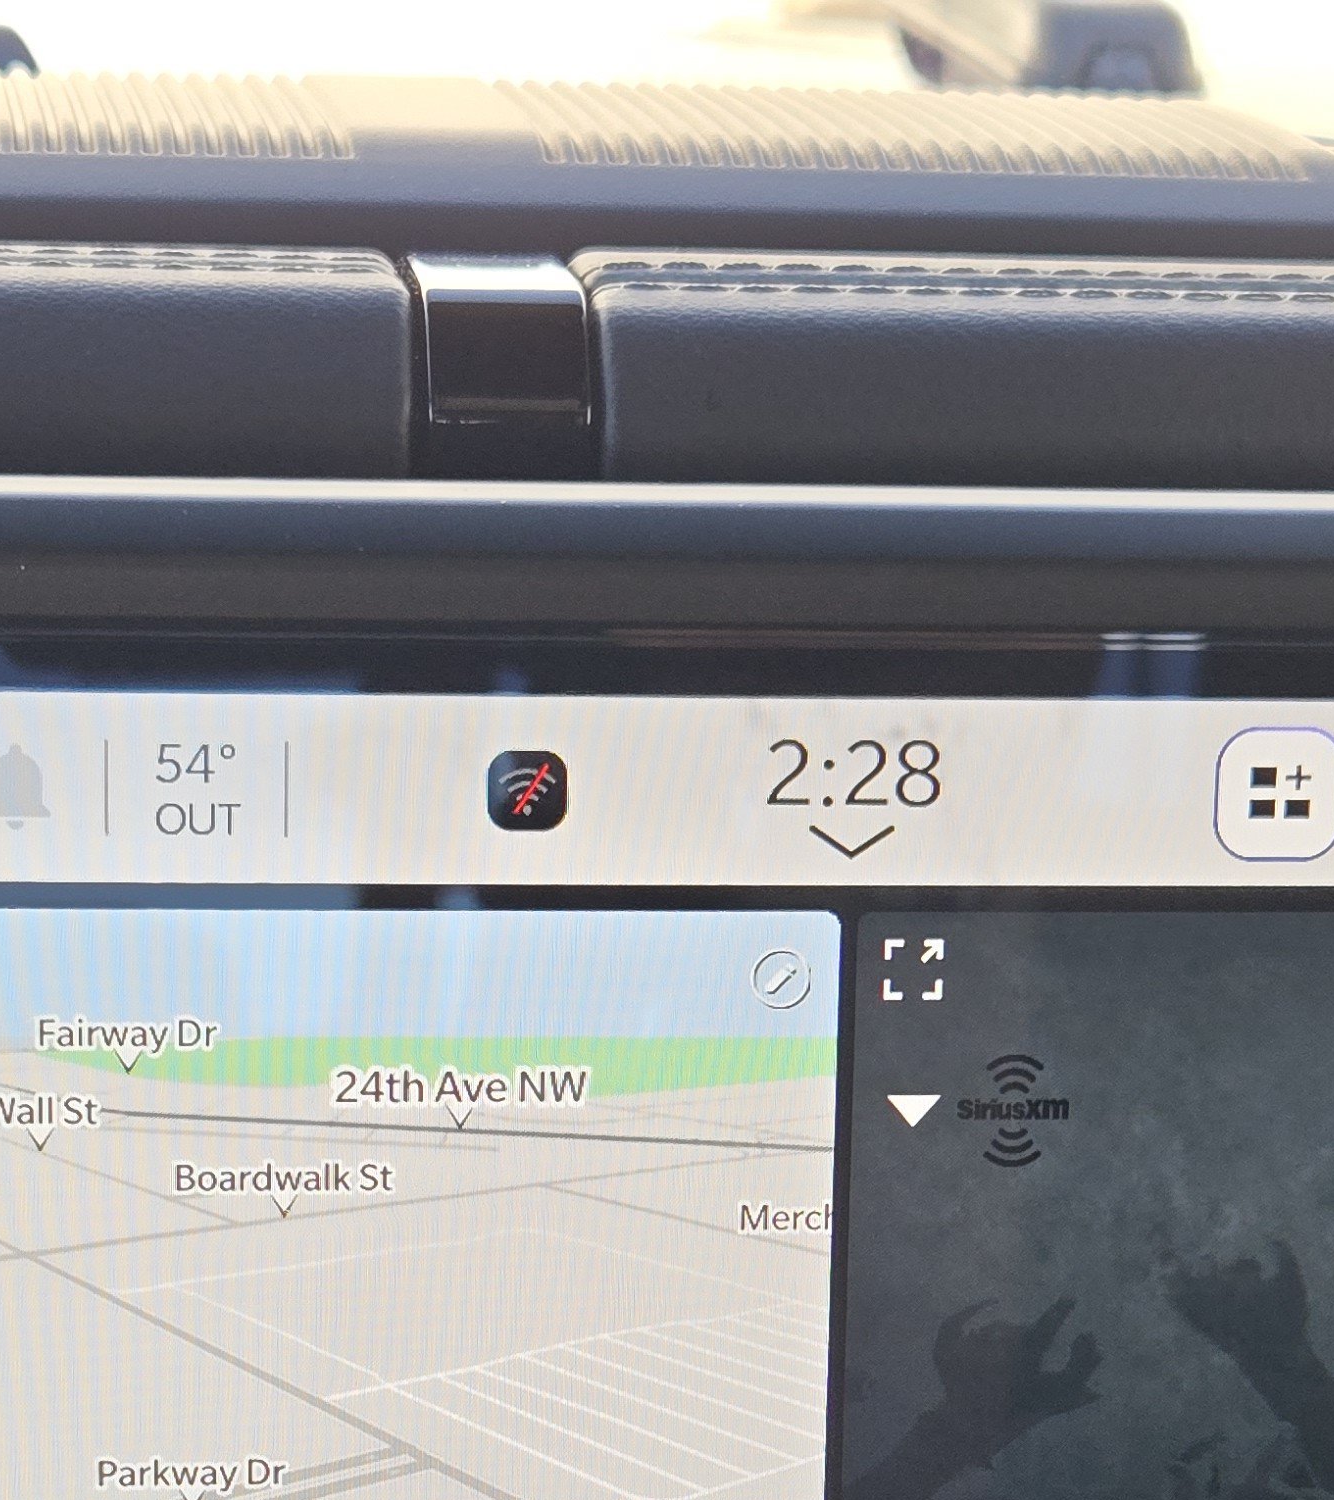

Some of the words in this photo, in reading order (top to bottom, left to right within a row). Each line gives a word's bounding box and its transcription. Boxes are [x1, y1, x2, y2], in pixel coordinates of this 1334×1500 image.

[154, 742, 237, 784] 54°
[766, 738, 942, 808] 2:28
[154, 801, 241, 836] OUT
[38, 1018, 169, 1050] Fairway
[178, 1020, 218, 1047] Dr
[334, 1069, 425, 1104] 24th
[435, 1072, 507, 1104] Ave
[519, 1071, 587, 1102] NW
[64, 1097, 99, 1126] St
[174, 1163, 350, 1193] Boardwalk
[361, 1165, 394, 1193] St
[97, 1457, 236, 1491] Parkway
[247, 1458, 287, 1485] Dr
